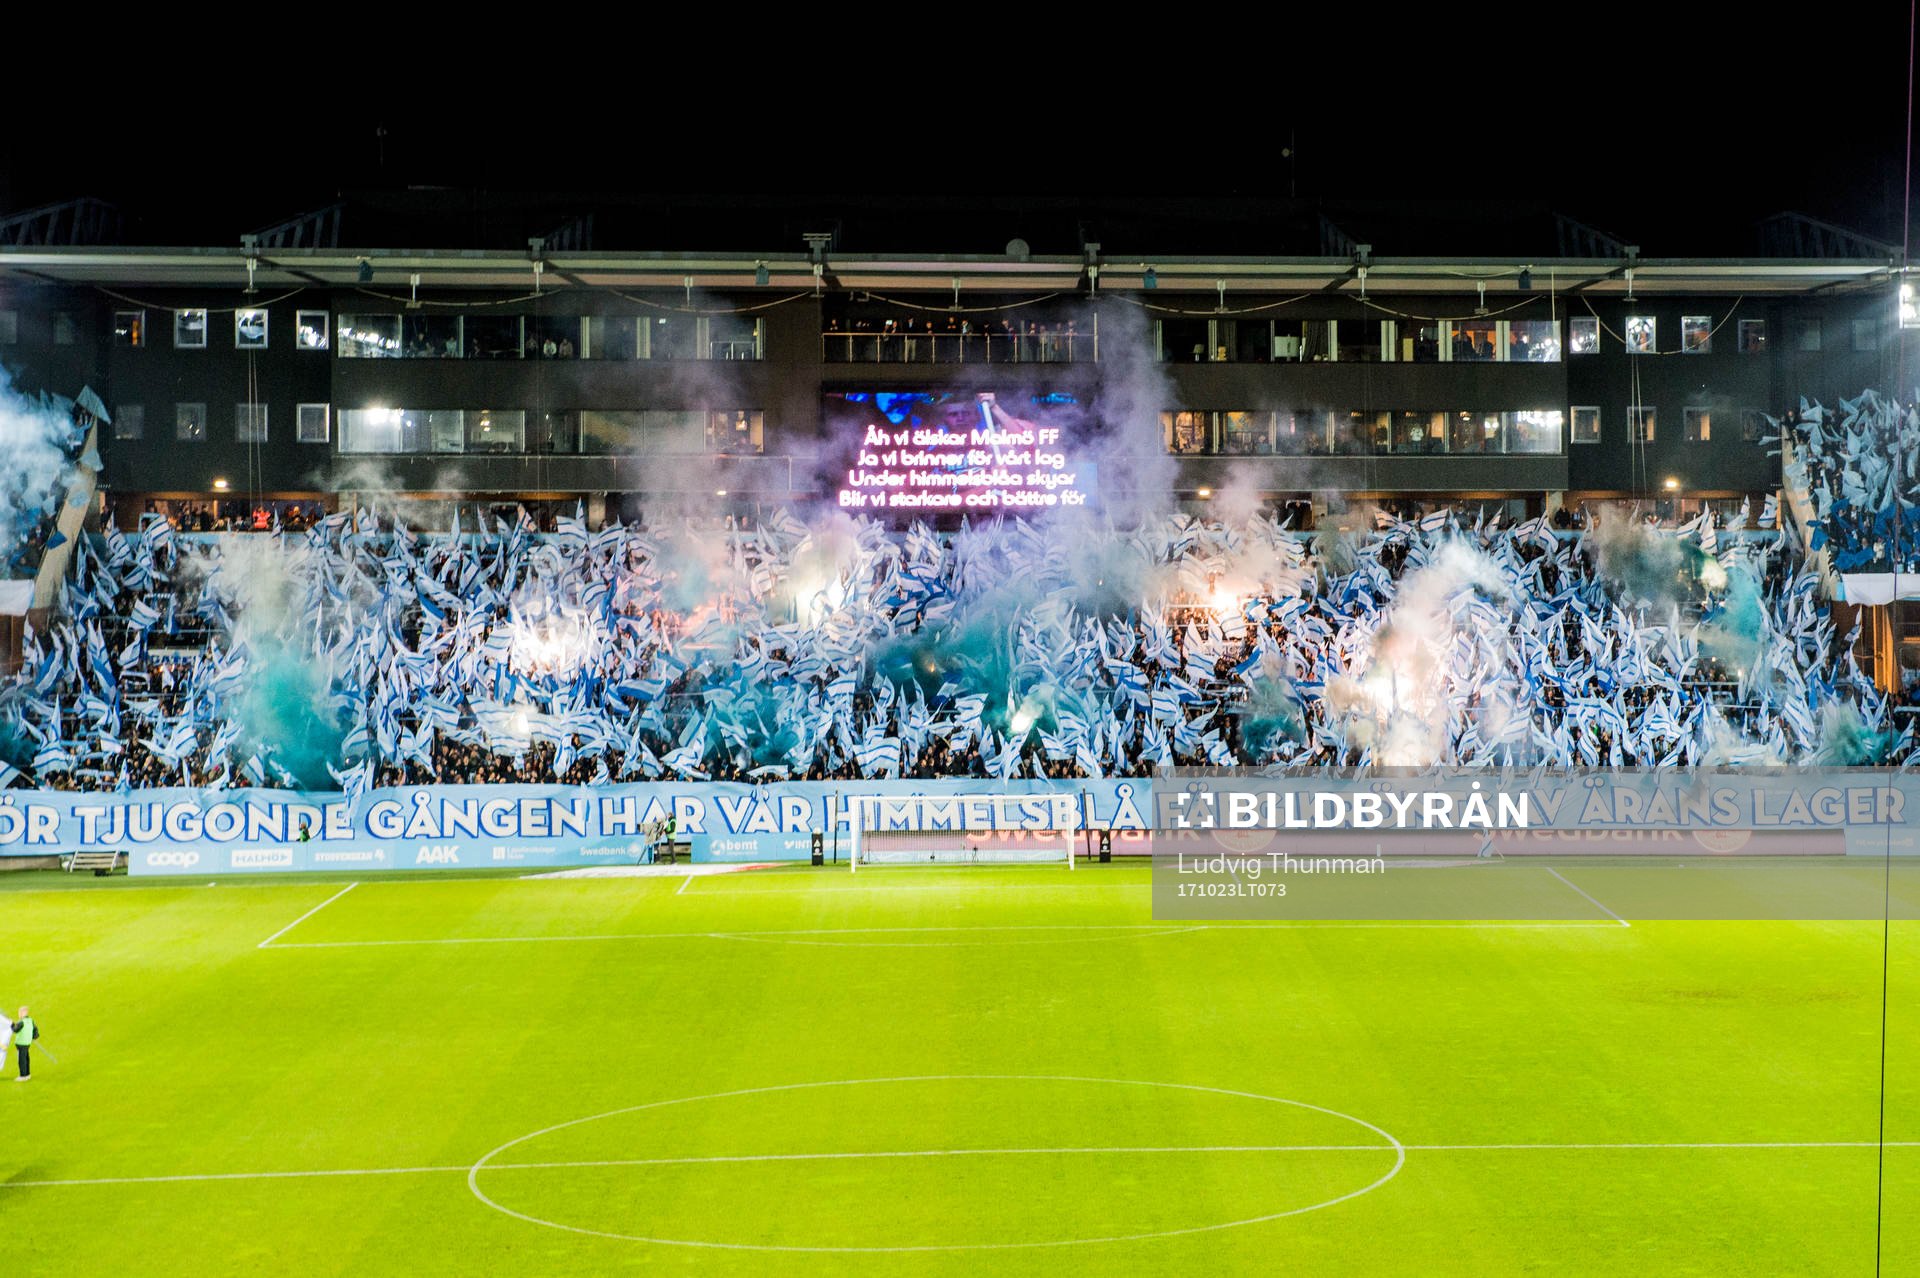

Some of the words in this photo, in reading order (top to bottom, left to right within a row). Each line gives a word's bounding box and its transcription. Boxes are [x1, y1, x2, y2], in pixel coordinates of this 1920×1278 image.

[864, 424, 890, 445] Åh
[894, 430, 909, 445] vi
[912, 429, 967, 445] älskar
[970, 428, 1035, 445] Malmö
[1039, 428, 1059, 445] FF
[857, 449, 879, 466] Ja
[882, 450, 897, 466] vi
[900, 449, 965, 466] brinner
[967, 449, 993, 466] för
[995, 449, 1031, 466] vårt
[1035, 449, 1065, 469] lag
[849, 469, 907, 486] Under
[1026, 469, 1076, 489] skyar
[839, 489, 868, 507] Blir
[870, 490, 886, 507] vi
[889, 489, 963, 507] starkare
[965, 488, 998, 506] och
[1001, 488, 1058, 506] bättre
[1060, 488, 1087, 505] för
[71, 801, 355, 845] TJUGONDE
[365, 791, 587, 839] GÅNGEN
[599, 796, 708, 836] HAR
[823, 782, 1148, 832] HIMMELSBLÅ
[1579, 777, 1741, 826] ÄRANS
[1752, 786, 1906, 827] LAGER
[147, 851, 200, 868] coop
[415, 845, 459, 864] AAK
[579, 846, 626, 856] Swedbank
